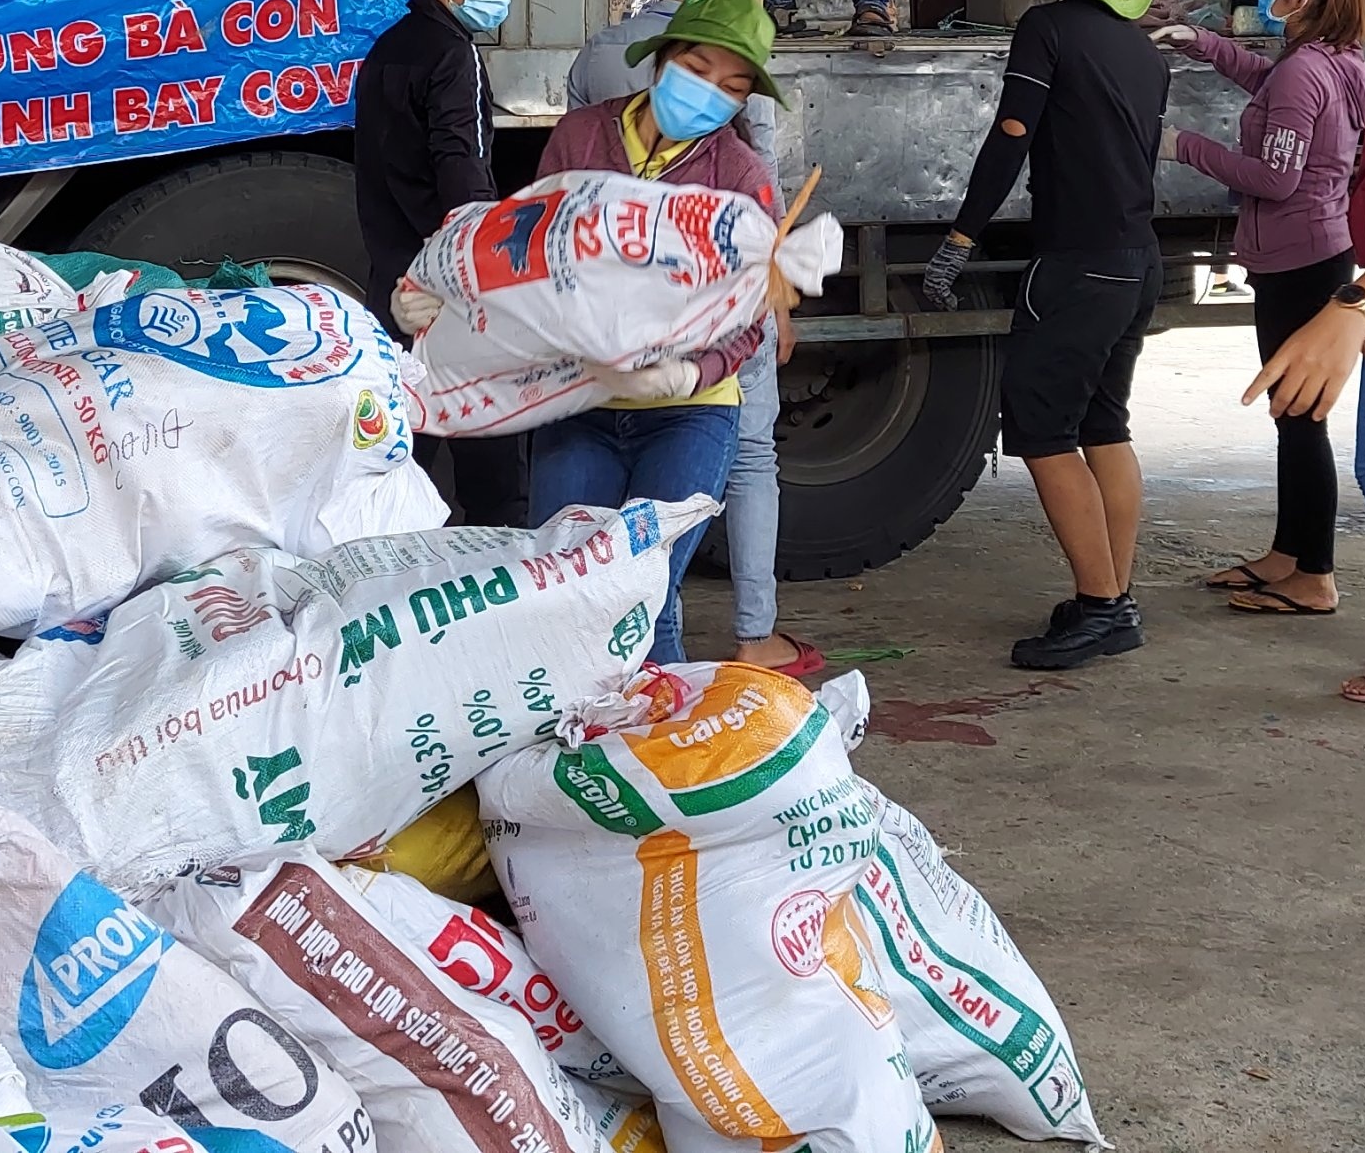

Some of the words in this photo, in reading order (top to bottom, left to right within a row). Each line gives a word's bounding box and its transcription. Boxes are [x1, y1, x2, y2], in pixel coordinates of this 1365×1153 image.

[121, 0, 206, 60] BÀ
[113, 77, 225, 136] BAY
[239, 59, 365, 120] COV
[73, 395, 98, 424] 50
[13, 412, 44, 448] 9001
[43, 453, 67, 489] 2015
[84, 425, 110, 465] KG
[7, 475, 27, 509] CON
[408, 564, 521, 646] PHÚ
[338, 604, 403, 689] MỸ
[272, 652, 323, 693] Cho
[463, 689, 511, 758] 1,0%
[518, 667, 564, 736] 0,4%
[669, 686, 770, 748] Cargill
[156, 707, 203, 751] bội
[772, 796, 820, 824] THỨC
[787, 815, 834, 848] CHO
[821, 843, 845, 867] 20
[49, 902, 162, 995] PROM
[264, 885, 312, 938] HỖN
[296, 924, 341, 967] HỢP
[331, 948, 375, 995] CHO
[362, 976, 409, 1024] LỢN
[396, 1009, 442, 1051] SIÊU
[433, 1038, 477, 1077] NẠC
[463, 1060, 501, 1096] TỪ
[485, 1088, 517, 1123] 10
[680, 968, 698, 1005] HỢP
[947, 976, 1002, 1029] NPK
[686, 1007, 713, 1055] HOÀN
[1015, 1052, 1035, 1075] ISO
[1027, 1021, 1053, 1057] 9001
[336, 1104, 372, 1151] PC
[736, 1096, 765, 1130] CHO
